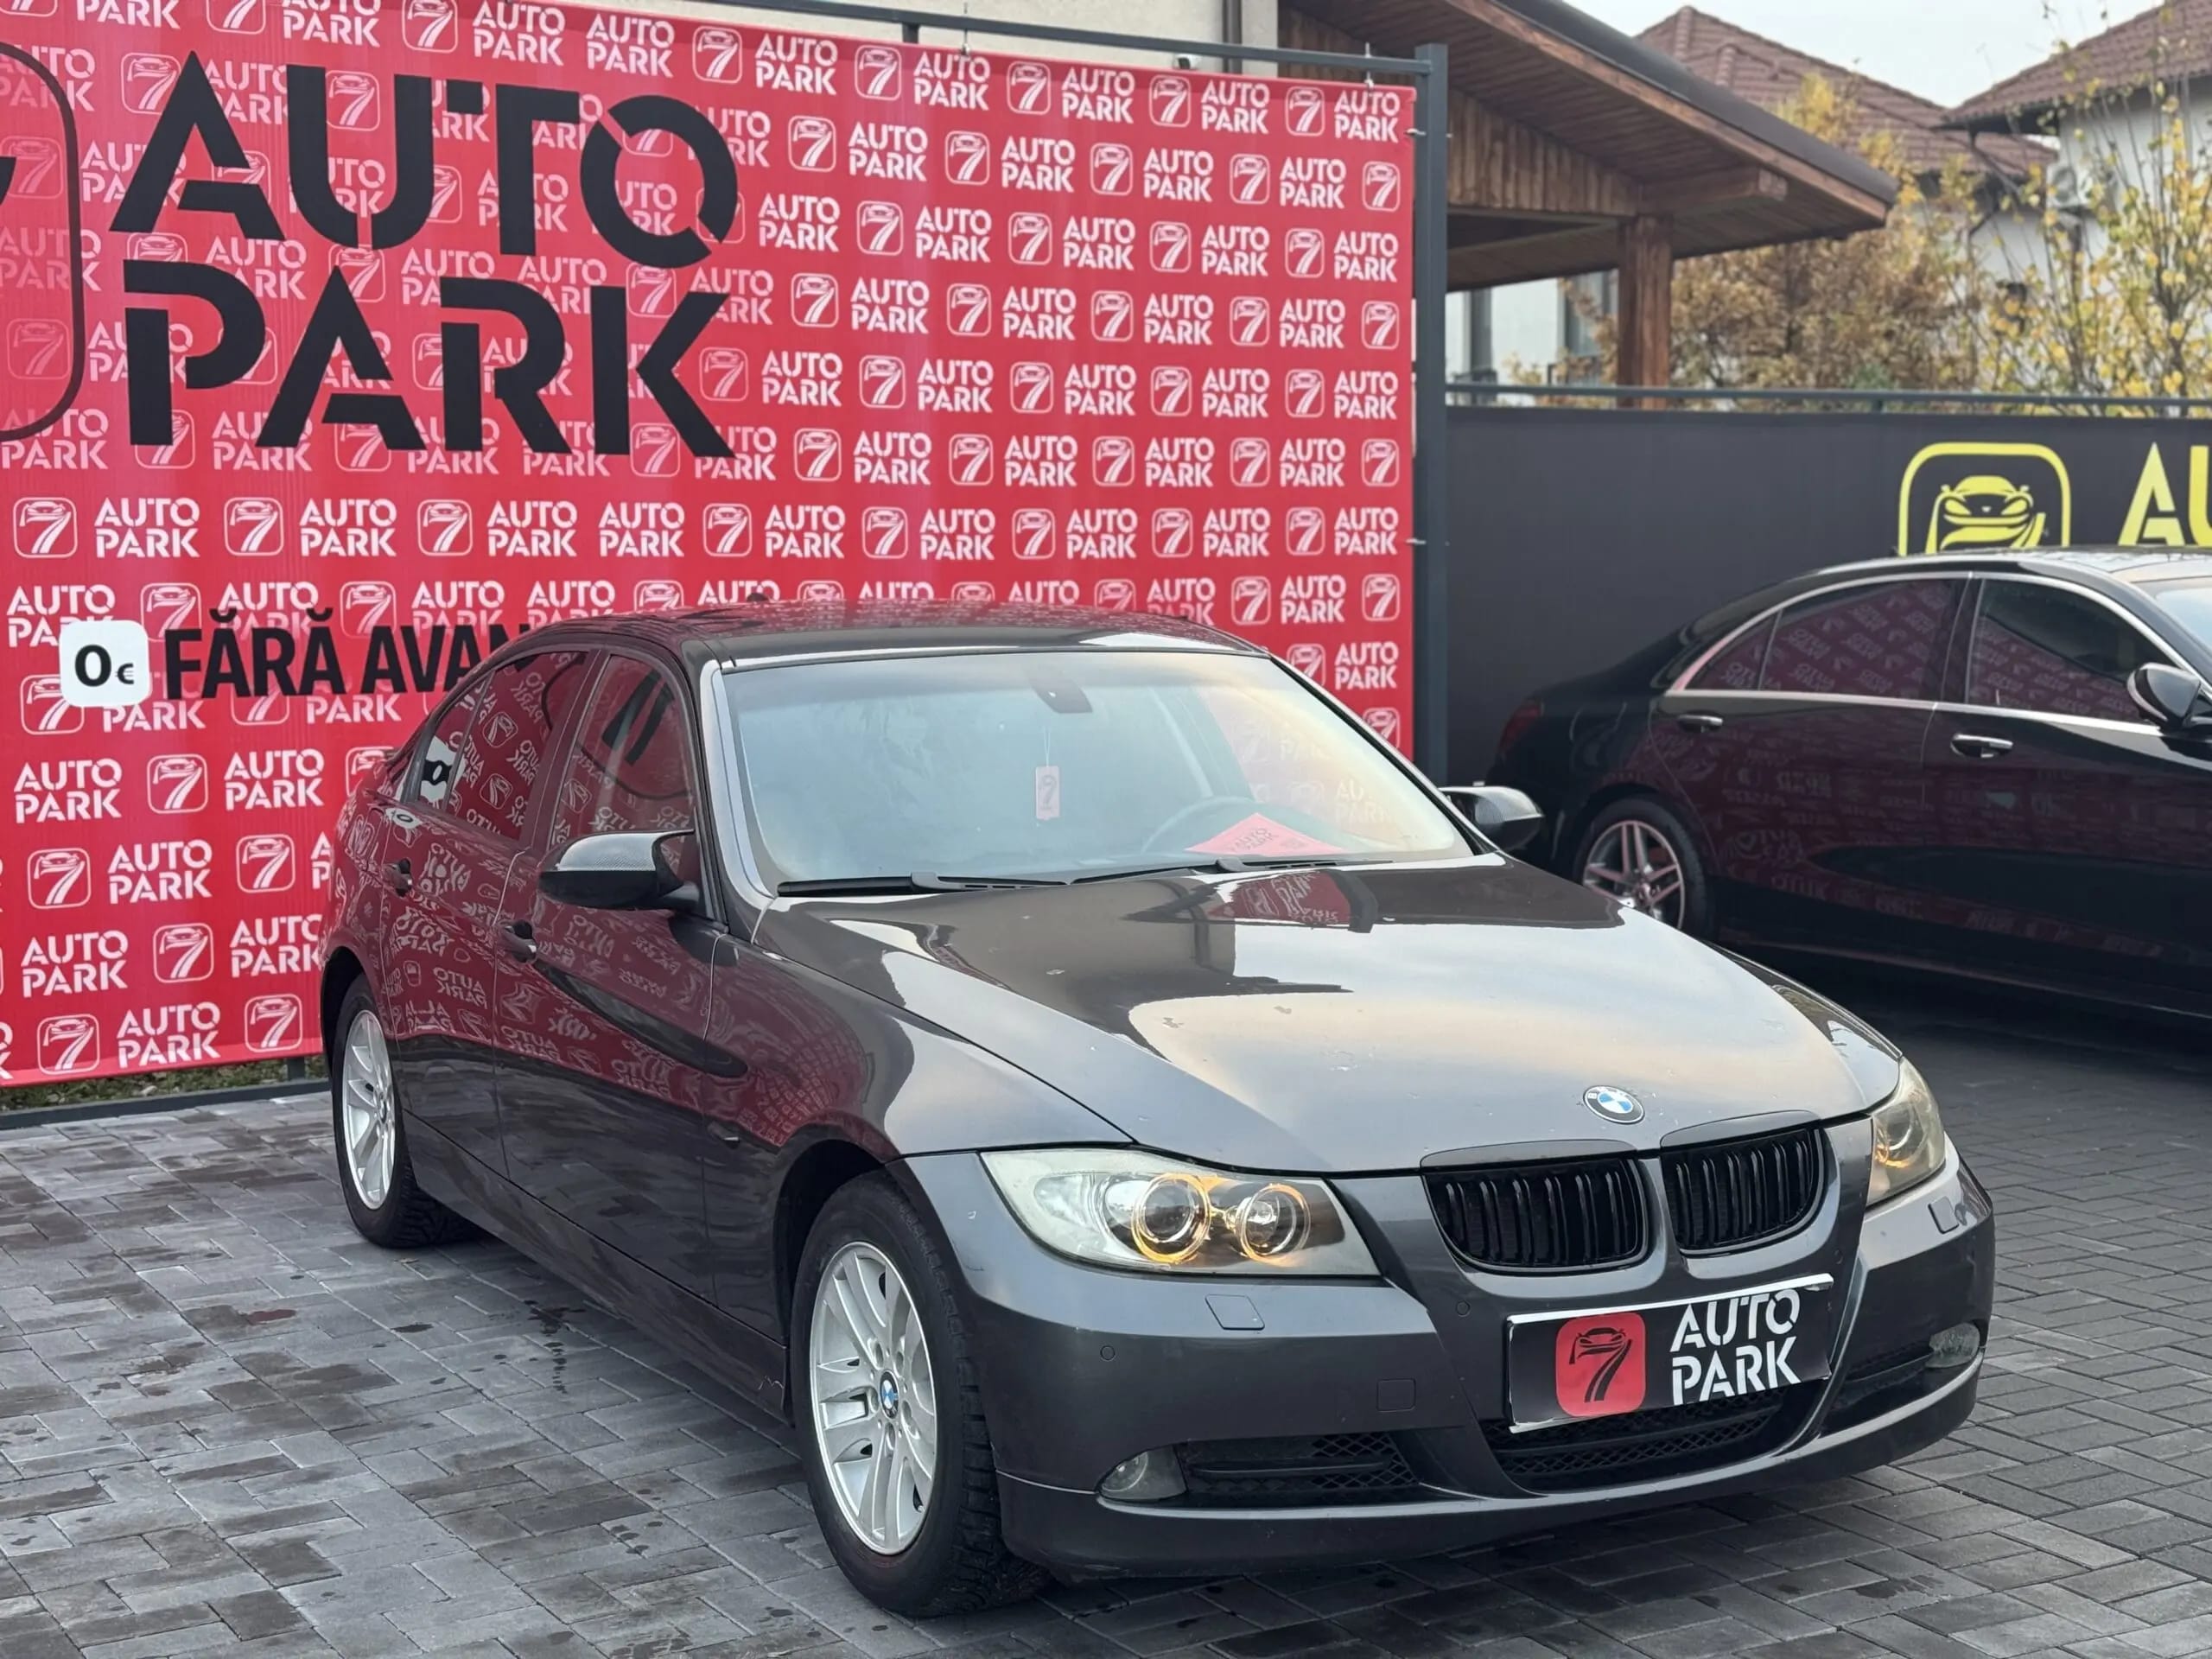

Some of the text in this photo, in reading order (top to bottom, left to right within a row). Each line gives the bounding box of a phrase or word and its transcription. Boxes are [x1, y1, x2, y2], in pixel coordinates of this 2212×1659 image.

[283, 10, 380, 48] PARK
[473, 0, 567, 35] AUTO
[586, 12, 677, 48] AUTO
[474, 29, 563, 66] PARK
[588, 41, 672, 77] PARK
[755, 31, 840, 67] AUTO
[756, 60, 836, 95] PARK
[913, 50, 992, 83] AUTO
[915, 78, 988, 111] PARK
[1062, 67, 1136, 97] AUTO
[1201, 81, 1269, 108] AUTO
[1063, 92, 1133, 124] PARK
[1334, 91, 1400, 116] AUTO
[1202, 105, 1268, 134] PARK
[1335, 113, 1398, 143] PARK
[849, 122, 927, 153] AUTO
[1001, 137, 1075, 165] AUTO
[109, 50, 739, 270] AUTO
[849, 149, 926, 181] PARK
[1144, 149, 1213, 175] AUTO
[1280, 157, 1346, 183] AUTO
[1002, 162, 1073, 192] PARK
[1144, 173, 1211, 201] PARK
[1281, 181, 1344, 208] PARK
[759, 194, 840, 224] AUTO
[916, 207, 991, 235] AUTO
[760, 220, 838, 251] PARK
[1064, 217, 1135, 244] AUTO
[1202, 226, 1269, 251] AUTO
[1334, 232, 1398, 257] AUTO
[206, 236, 307, 270] AUTO
[917, 232, 989, 262] PARK
[1064, 242, 1134, 270] PARK
[402, 248, 495, 278] AUTO
[518, 256, 607, 285] AUTO
[1203, 249, 1268, 276] PARK
[1334, 255, 1396, 282] PARK
[691, 267, 774, 297] AUTO
[851, 278, 929, 307] AUTO
[1003, 287, 1076, 314] AUTO
[1144, 294, 1213, 320] AUTO
[1280, 299, 1345, 323] AUTO
[852, 304, 928, 334] PARK
[1004, 313, 1074, 340] PARK
[1145, 318, 1211, 345] PARK
[1281, 322, 1344, 348] PARK
[123, 259, 734, 458] PARK
[762, 351, 842, 378] AUTO
[918, 359, 993, 386] AUTO
[1065, 365, 1136, 390] AUTO
[1203, 369, 1269, 392] AUTO
[1334, 372, 1398, 395] AUTO
[763, 378, 841, 406] PARK
[918, 385, 992, 412] PARK
[1065, 389, 1135, 415] PARK
[1203, 393, 1268, 417] PARK
[1335, 394, 1396, 419] PARK
[1, 440, 109, 470] PARK
[213, 442, 312, 471] PARK
[854, 431, 931, 458] AUTO
[1005, 435, 1077, 461] AUTO
[1145, 437, 1214, 461] AUTO
[1280, 438, 1345, 462] AUTO
[855, 457, 931, 485] PARK
[1006, 461, 1076, 486] PARK
[1146, 462, 1212, 486] PARK
[1281, 462, 1344, 486] PARK
[95, 498, 200, 526] AUTO
[300, 499, 397, 526] AUTO
[487, 501, 577, 528] AUTO
[599, 503, 684, 529] AUTO
[765, 505, 845, 531] AUTO
[920, 509, 995, 534] AUTO
[1067, 508, 1137, 533] AUTO
[1204, 508, 1270, 532] AUTO
[1334, 507, 1398, 531] AUTO
[97, 528, 199, 557] PARK
[302, 528, 396, 556] PARK
[488, 529, 576, 556] PARK
[601, 530, 683, 556] PARK
[766, 531, 843, 558] PARK
[921, 535, 994, 560] PARK
[1067, 534, 1135, 558] PARK
[1204, 532, 1268, 556] PARK
[1335, 531, 1396, 555] PARK
[7, 583, 116, 617] AUTO
[218, 582, 320, 611] AUTO
[411, 581, 505, 609] AUTO
[526, 580, 616, 608] AUTO
[1008, 580, 1080, 604] AUTO
[1147, 577, 1216, 601] AUTO
[1281, 575, 1345, 600] AUTO
[1281, 599, 1344, 624] PARK
[164, 607, 346, 699] FĂRĂ
[1335, 641, 1398, 666] AUTO
[1336, 664, 1396, 690] PARK
[307, 694, 401, 724] PARK
[14, 759, 122, 791] AUTO
[225, 749, 324, 780] AUTO
[16, 789, 121, 823] PARK
[226, 779, 323, 810] PARK
[108, 840, 212, 874] AUTO
[110, 869, 211, 904] PARK
[21, 931, 128, 966] AUTO
[23, 960, 127, 997] PARK
[118, 1002, 220, 1038] AUTO
[118, 1031, 221, 1068] PARK
[1669, 1288, 1801, 1352] AUTO
[1672, 1336, 1802, 1406] PARK
